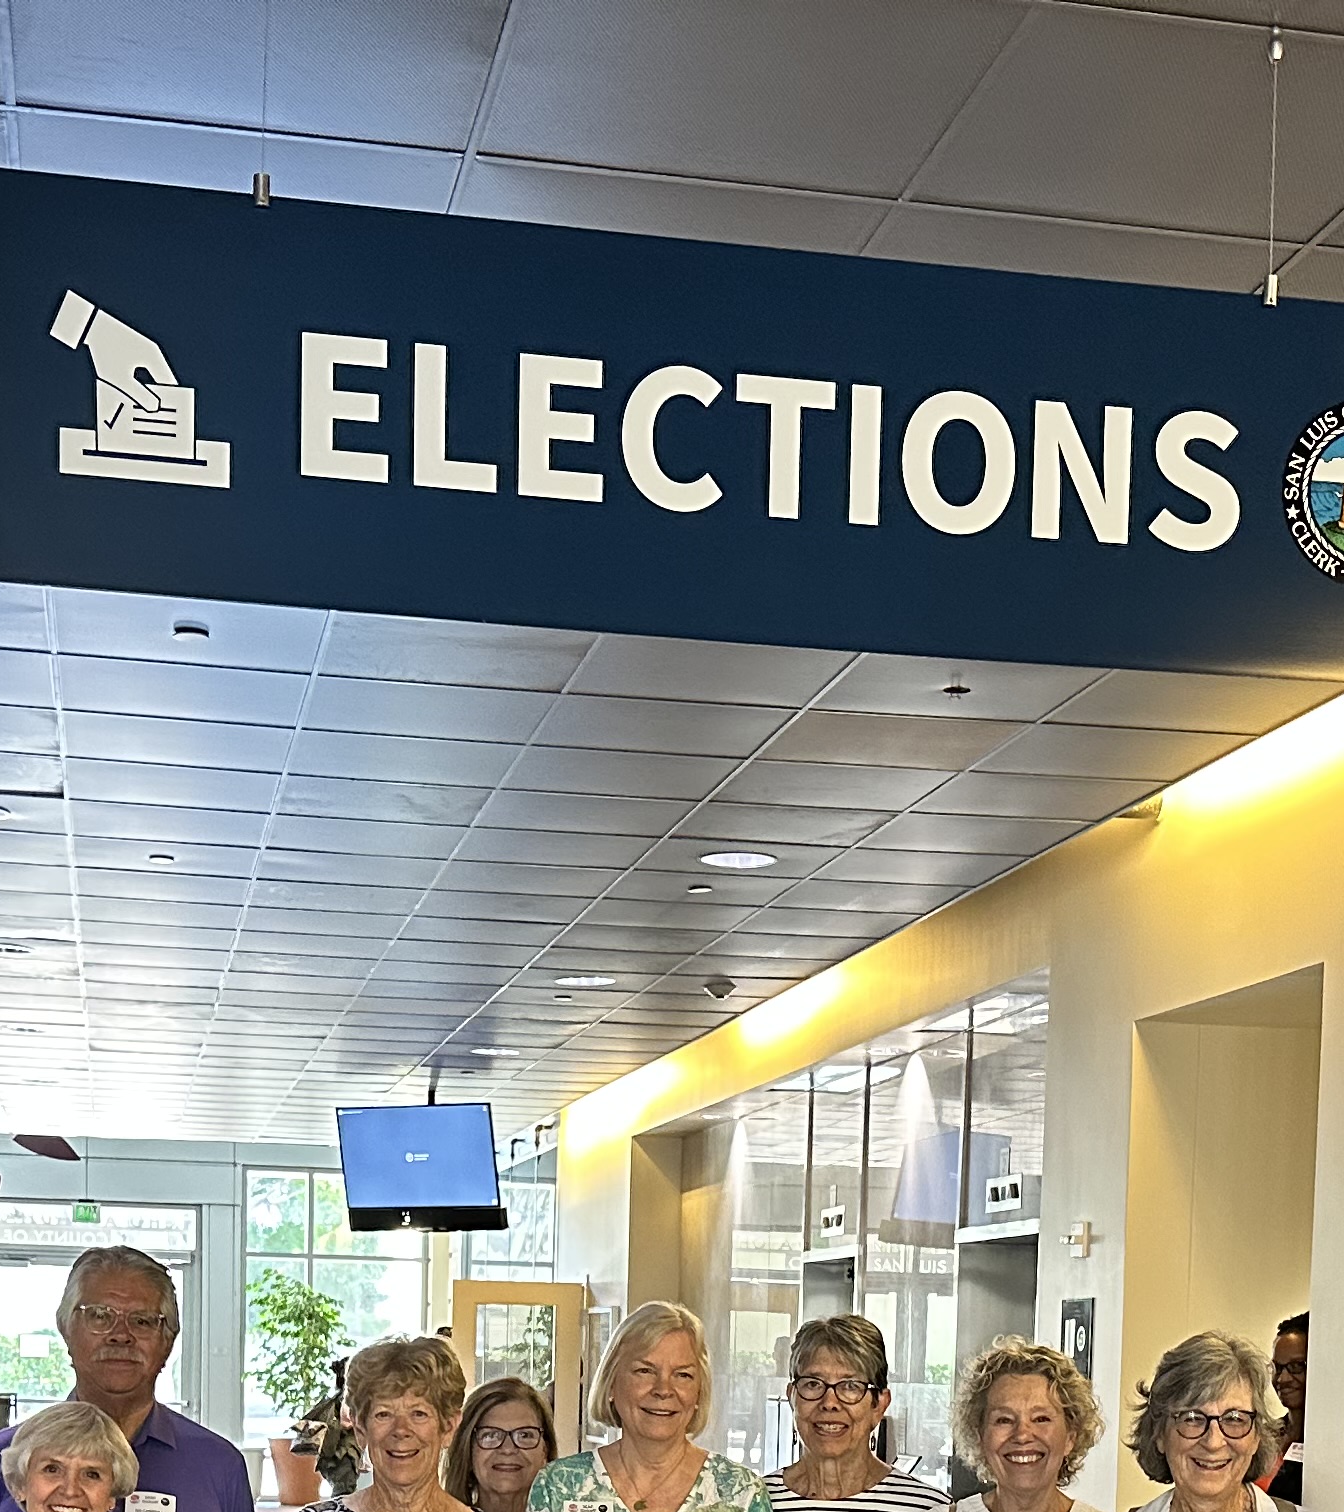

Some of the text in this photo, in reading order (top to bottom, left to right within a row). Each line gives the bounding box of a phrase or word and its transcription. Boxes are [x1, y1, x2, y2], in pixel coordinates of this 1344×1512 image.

[299, 330, 1241, 553] ELECTIONS
[1284, 453, 1306, 501] SAN
[1299, 410, 1338, 451] LUIS
[1291, 521, 1341, 578] CLERK
